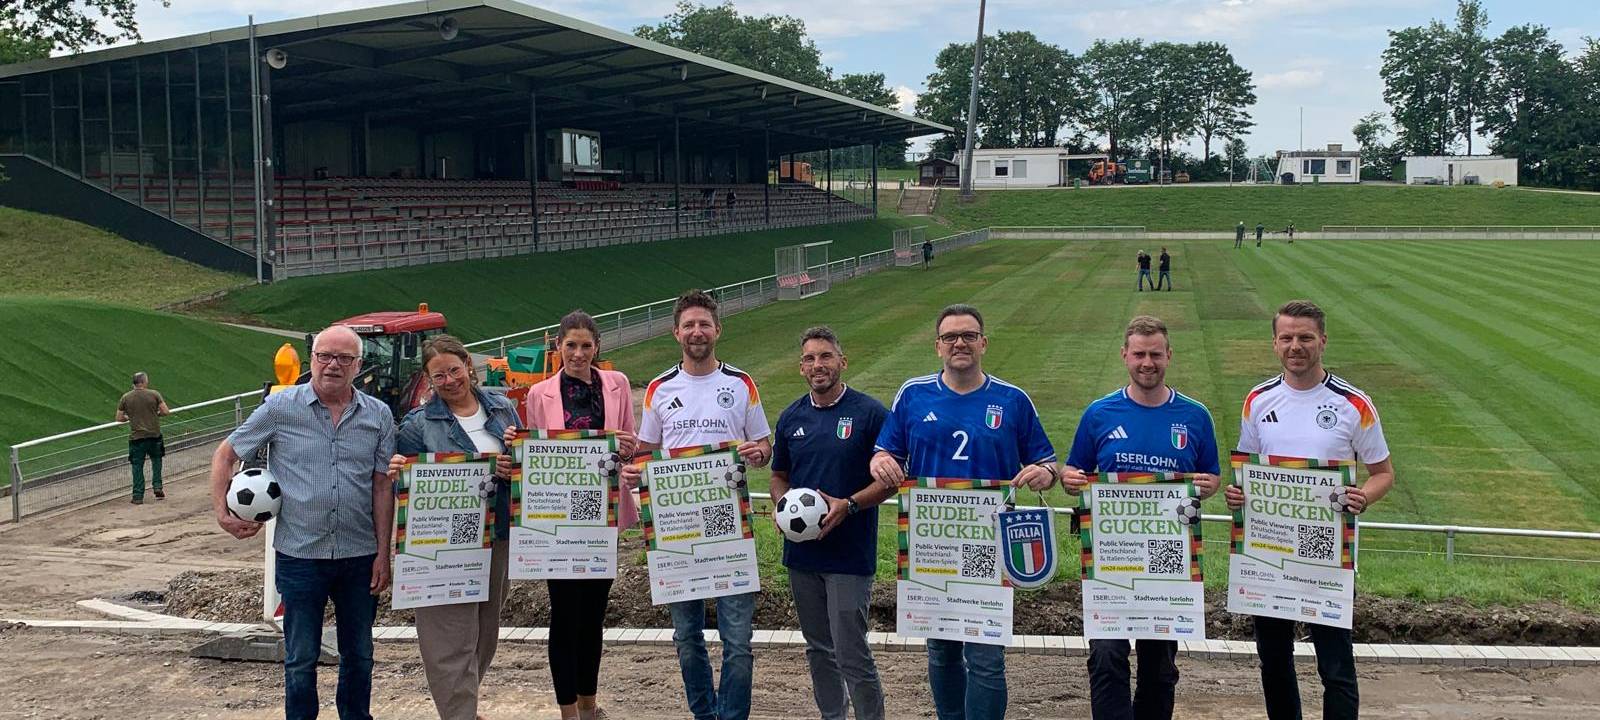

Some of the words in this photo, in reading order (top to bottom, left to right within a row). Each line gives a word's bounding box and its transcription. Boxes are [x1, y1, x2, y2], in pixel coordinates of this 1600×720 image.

[529, 445, 587, 454] BENVENUTI
[590, 446, 603, 454] AL
[951, 430, 969, 460] 2
[528, 455, 591, 470] RUDEL-
[653, 460, 713, 475] BENVENUTI
[715, 459, 729, 467] AL
[416, 468, 471, 477] BENVENUTI
[473, 468, 485, 476] AL
[528, 471, 602, 486] GUCKEN
[1248, 469, 1317, 485] BENVENUTI
[1319, 477, 1336, 487] AL
[415, 479, 473, 494] RUDEL-
[655, 471, 719, 491] RUDEL-
[657, 486, 732, 508] GUCKEN
[1098, 489, 1164, 498] BENVENUTI
[1166, 490, 1182, 499] AL
[1248, 480, 1322, 502] RUDEL-
[413, 495, 480, 511] GUCKEN
[916, 494, 980, 505] BENVENUTI
[982, 497, 997, 505] AL
[915, 505, 985, 522] RUDEL-
[1098, 501, 1169, 516] RUDEL-
[1250, 498, 1335, 522] GUCKEN
[915, 523, 996, 541] GUCKEN
[1099, 519, 1182, 535] GUCKEN
[1250, 517, 1268, 527] Public
[1269, 521, 1294, 532] Viewing
[1010, 526, 1041, 540] ITALIA
[934, 543, 959, 552] Viewing
[1118, 540, 1145, 548] Viewing
[1282, 574, 1317, 585] Stadtwerke
[946, 596, 980, 605] Stadtwerke
[1133, 594, 1168, 602] Stadtwerke
